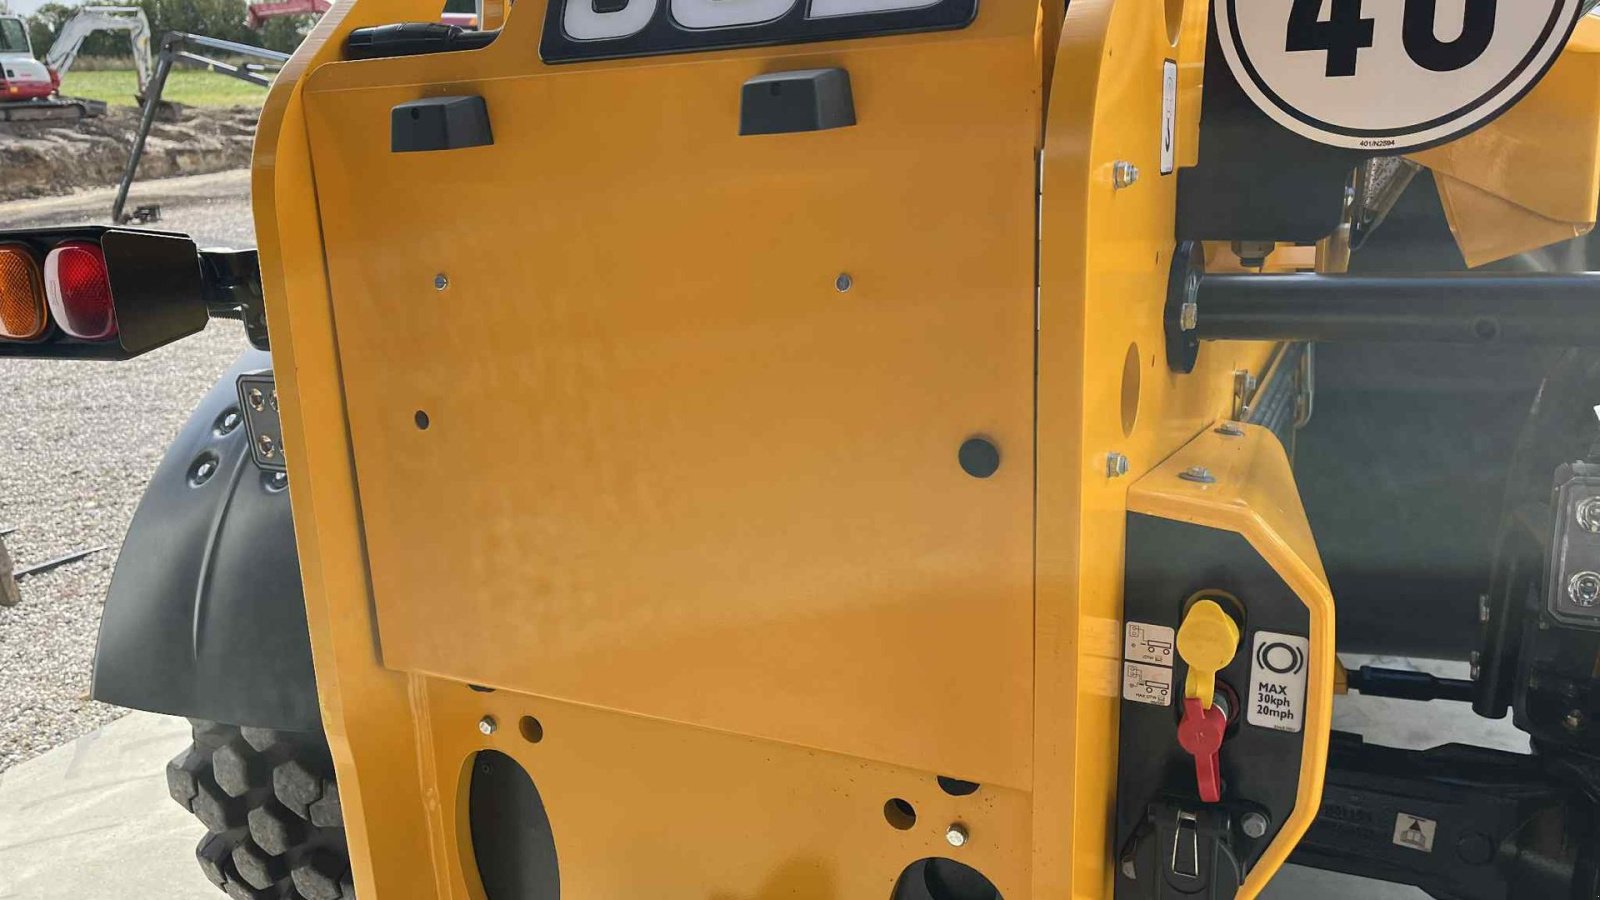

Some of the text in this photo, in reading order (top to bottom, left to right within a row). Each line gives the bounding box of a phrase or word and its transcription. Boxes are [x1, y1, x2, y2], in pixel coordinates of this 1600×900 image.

[1258, 682, 1288, 696] MAX
[1257, 692, 1290, 708] 30kph
[1256, 704, 1294, 720] 20mph
